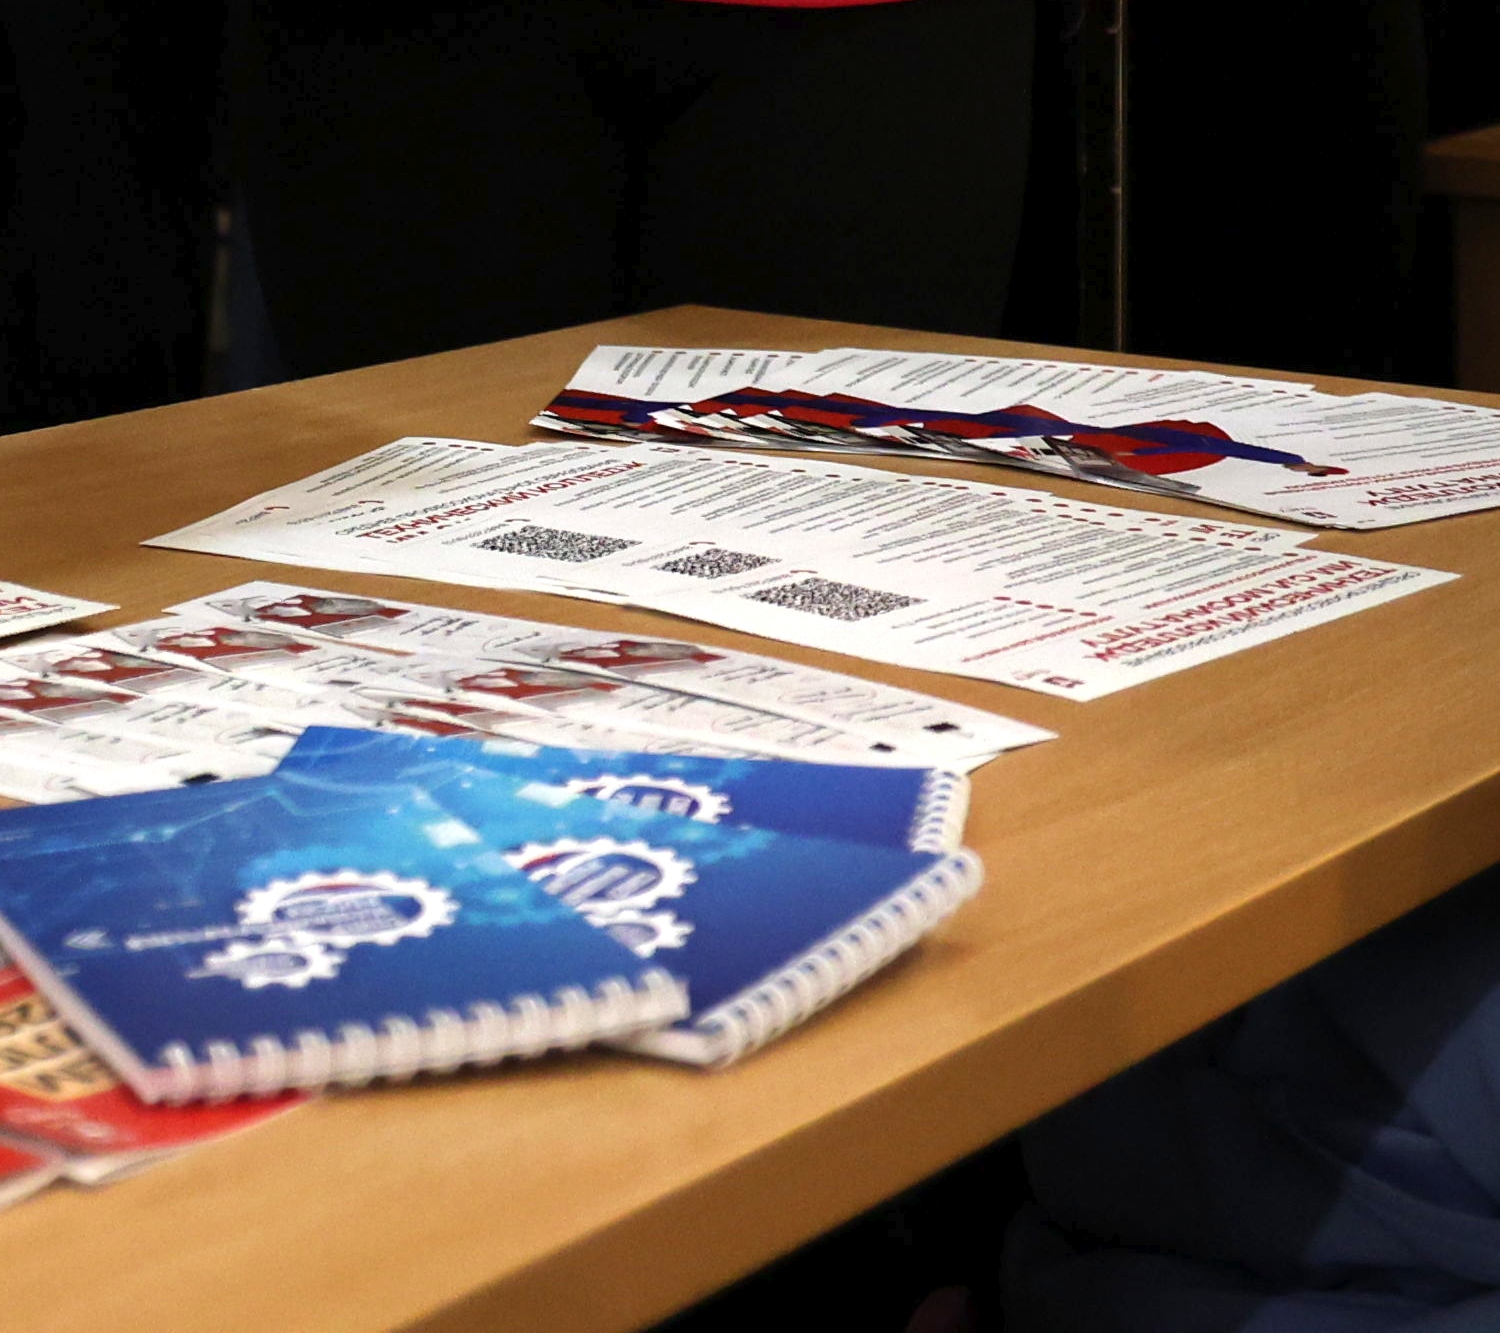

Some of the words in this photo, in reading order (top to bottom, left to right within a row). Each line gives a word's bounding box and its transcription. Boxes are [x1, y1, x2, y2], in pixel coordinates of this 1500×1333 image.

[355, 490, 539, 539] ТЕХНИЧЕСКИЙ
[537, 460, 647, 494] КОЛЛЕДЖ
[1152, 588, 1275, 625] МОСИНА
[1217, 567, 1397, 624] ТЕХНИЧЕСКИЙ
[1076, 621, 1169, 649] ТУЛГУ
[1082, 618, 1222, 663] КОЛЛЕДЖ
